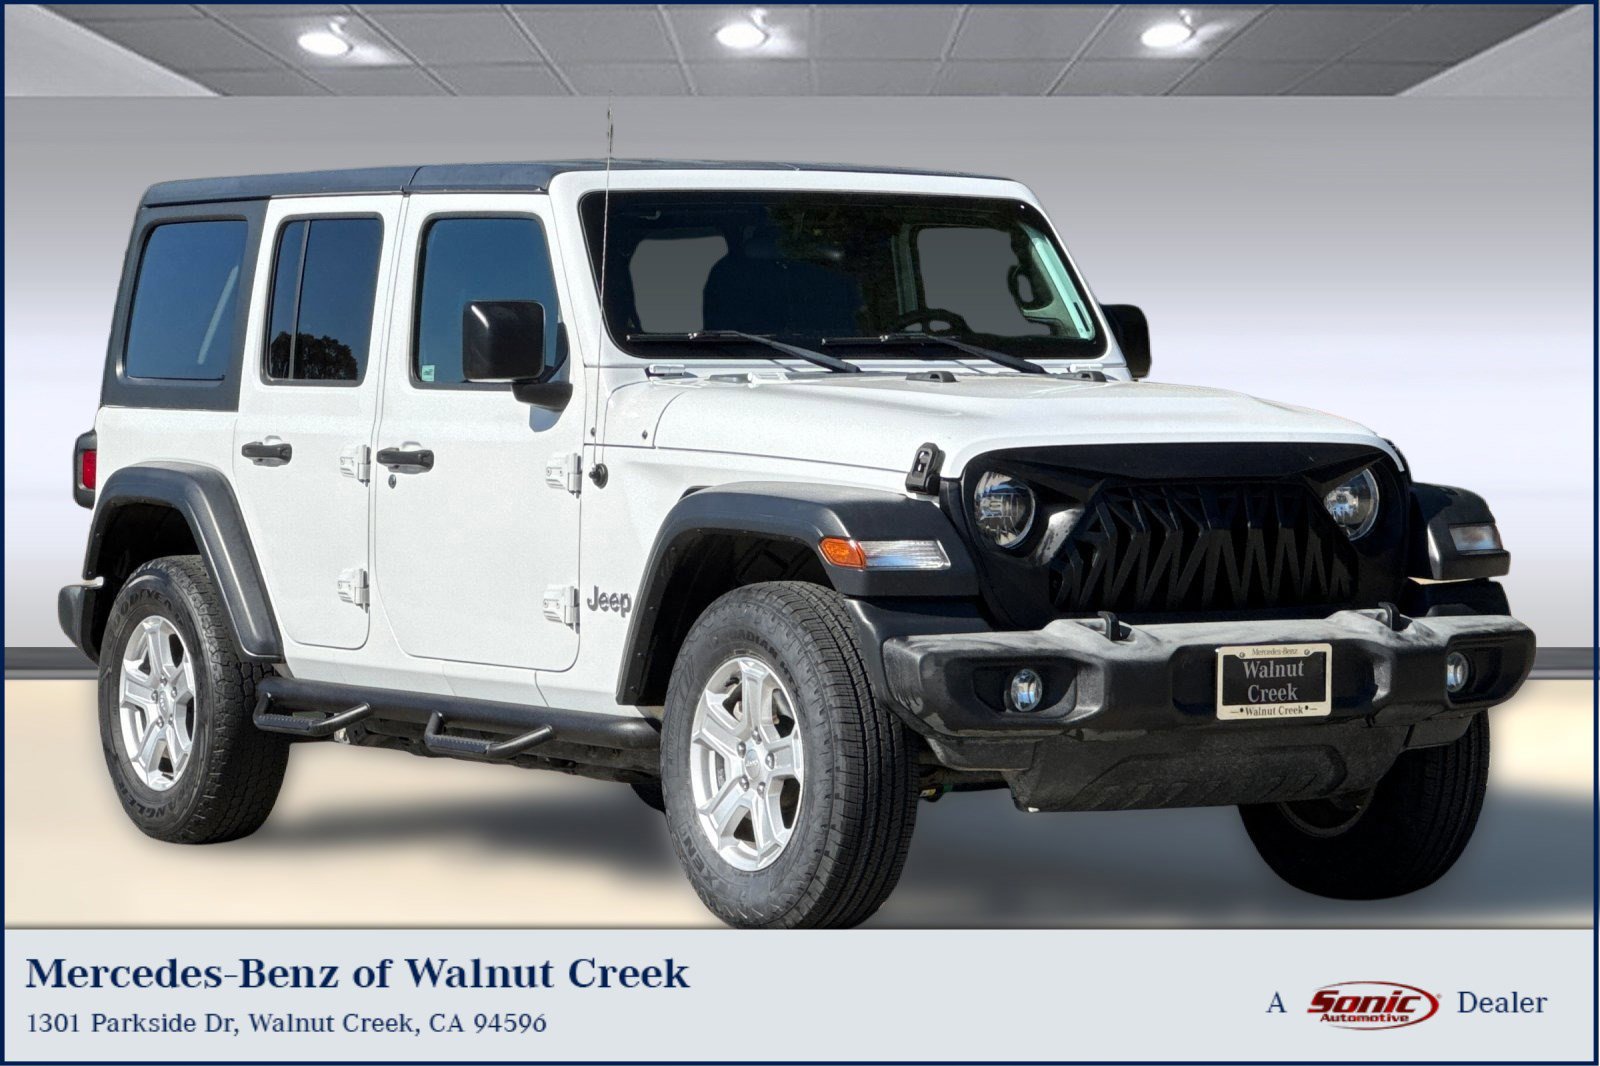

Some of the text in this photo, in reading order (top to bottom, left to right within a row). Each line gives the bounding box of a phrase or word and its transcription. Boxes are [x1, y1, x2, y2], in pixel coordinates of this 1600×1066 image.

[587, 585, 632, 618] Jeep
[1251, 647, 1299, 656] Mercedes-Benz
[1243, 660, 1305, 679] Walnut
[1247, 683, 1298, 703] Creek
[1245, 705, 1304, 717] Walnut Creek
[117, 781, 184, 818] ANGLER
